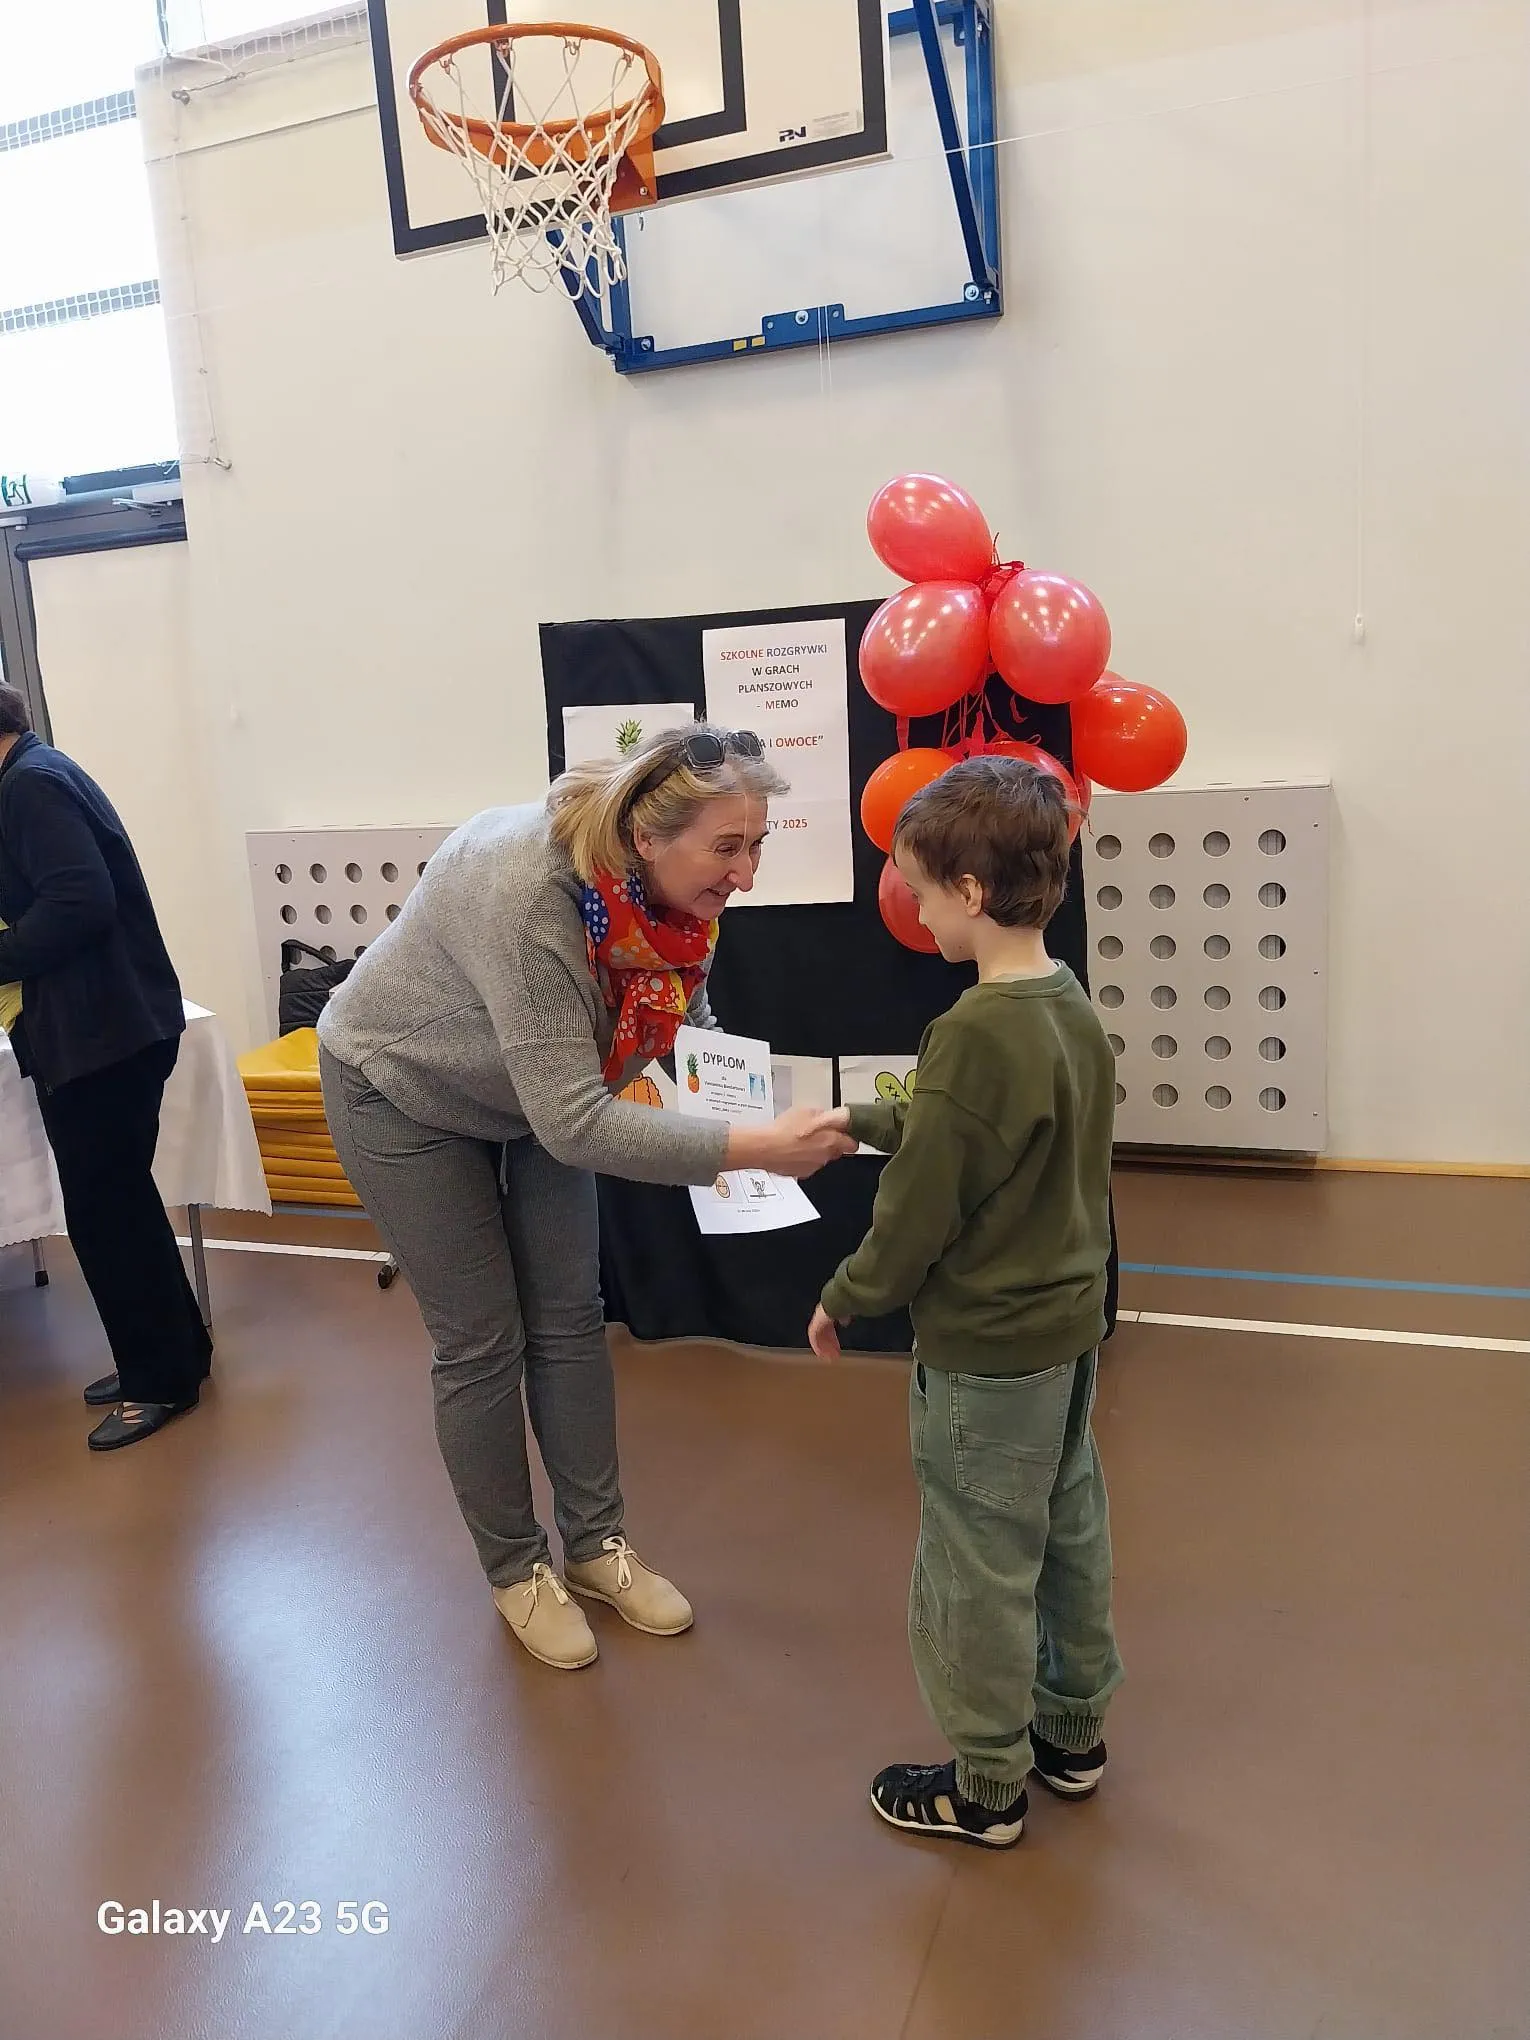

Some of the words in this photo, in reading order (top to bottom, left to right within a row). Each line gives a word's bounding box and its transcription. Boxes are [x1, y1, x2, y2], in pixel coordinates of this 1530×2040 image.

[720, 649, 764, 661] SZKOLNE
[766, 644, 827, 658] ROZGRYWKI
[752, 667, 762, 676] W
[765, 664, 800, 676] GRACH
[738, 680, 813, 694] PLANSZOWYCH
[765, 699, 798, 710] MEMO
[766, 820, 779, 830] TY
[782, 819, 808, 829] 2025
[703, 1051, 746, 1071] DYPLOM
